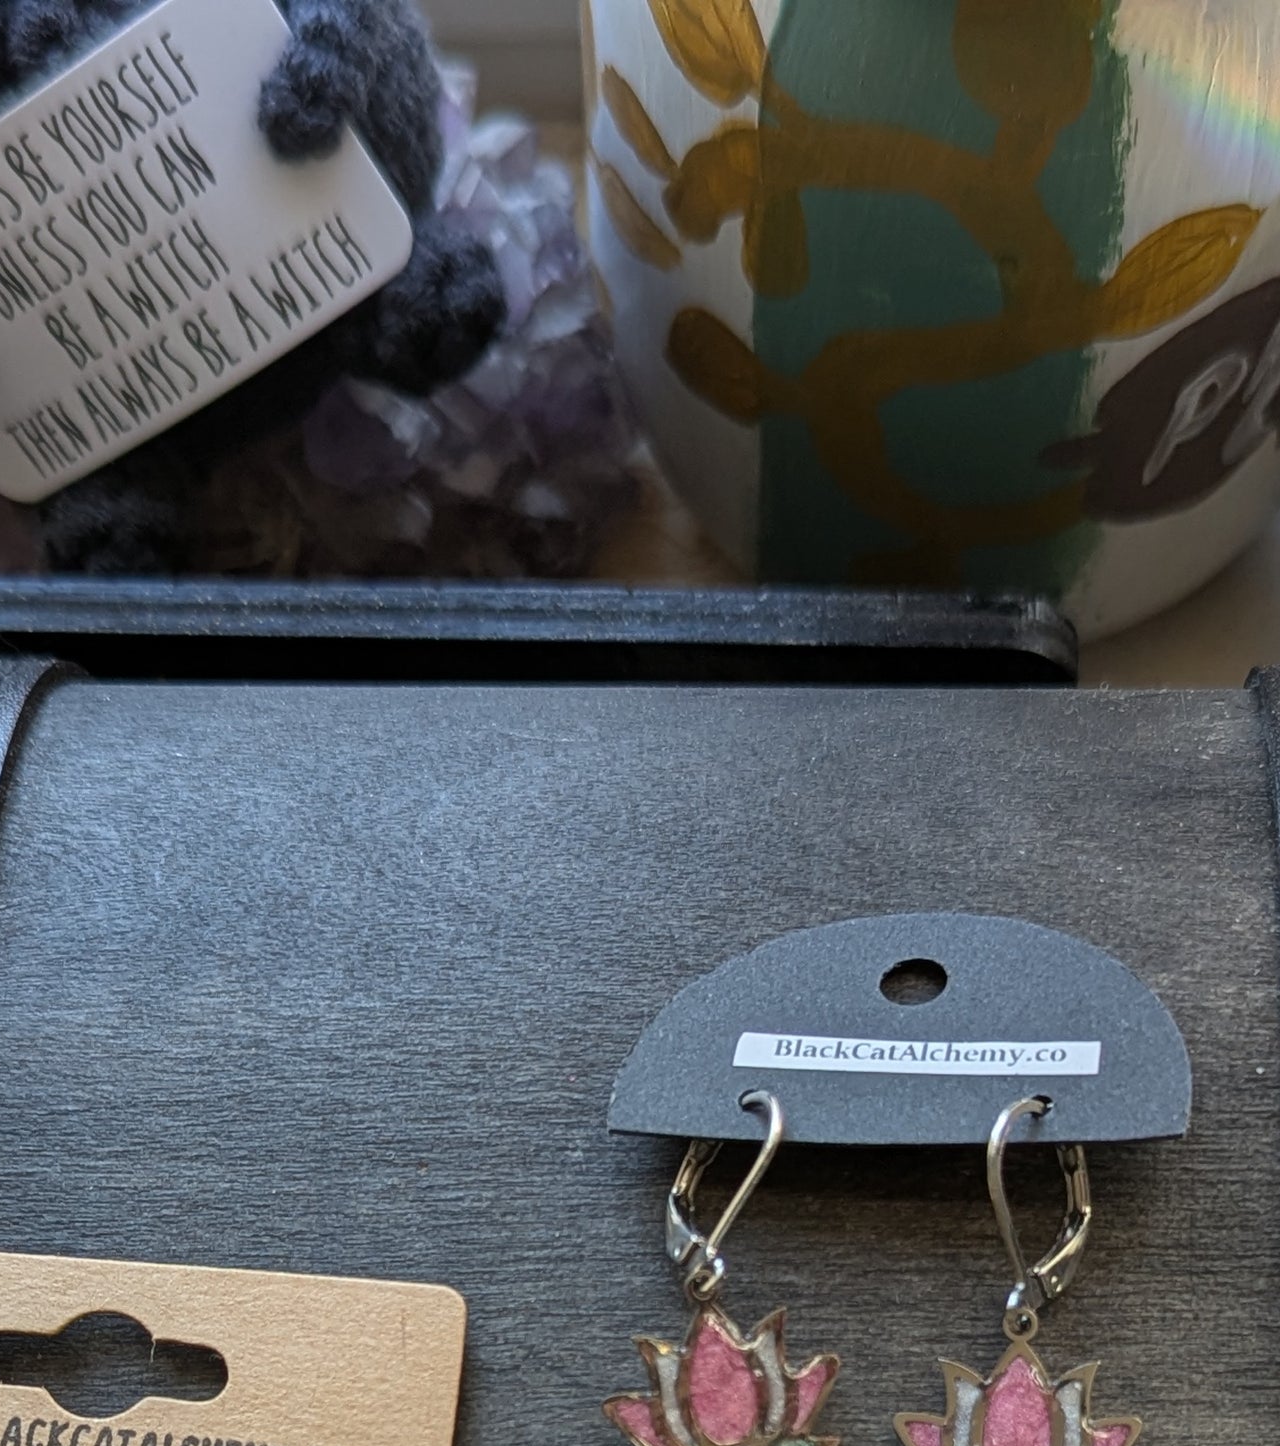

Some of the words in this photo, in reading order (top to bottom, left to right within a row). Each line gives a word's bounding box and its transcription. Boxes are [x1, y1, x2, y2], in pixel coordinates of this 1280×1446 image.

[4, 133, 64, 206] BE
[41, 32, 199, 177] YOURSELF
[66, 172, 148, 258] YOU
[135, 126, 217, 216] CAN
[105, 217, 231, 330] WITCH
[249, 215, 373, 330] WITCH
[44, 304, 103, 371] BE
[85, 286, 131, 349] A
[181, 307, 242, 378] BE
[227, 289, 272, 352] A
[76, 335, 198, 444] ALWAYS
[6, 402, 93, 479] THEN
[773, 1037, 1067, 1067] BlackCatAlchemy.co
